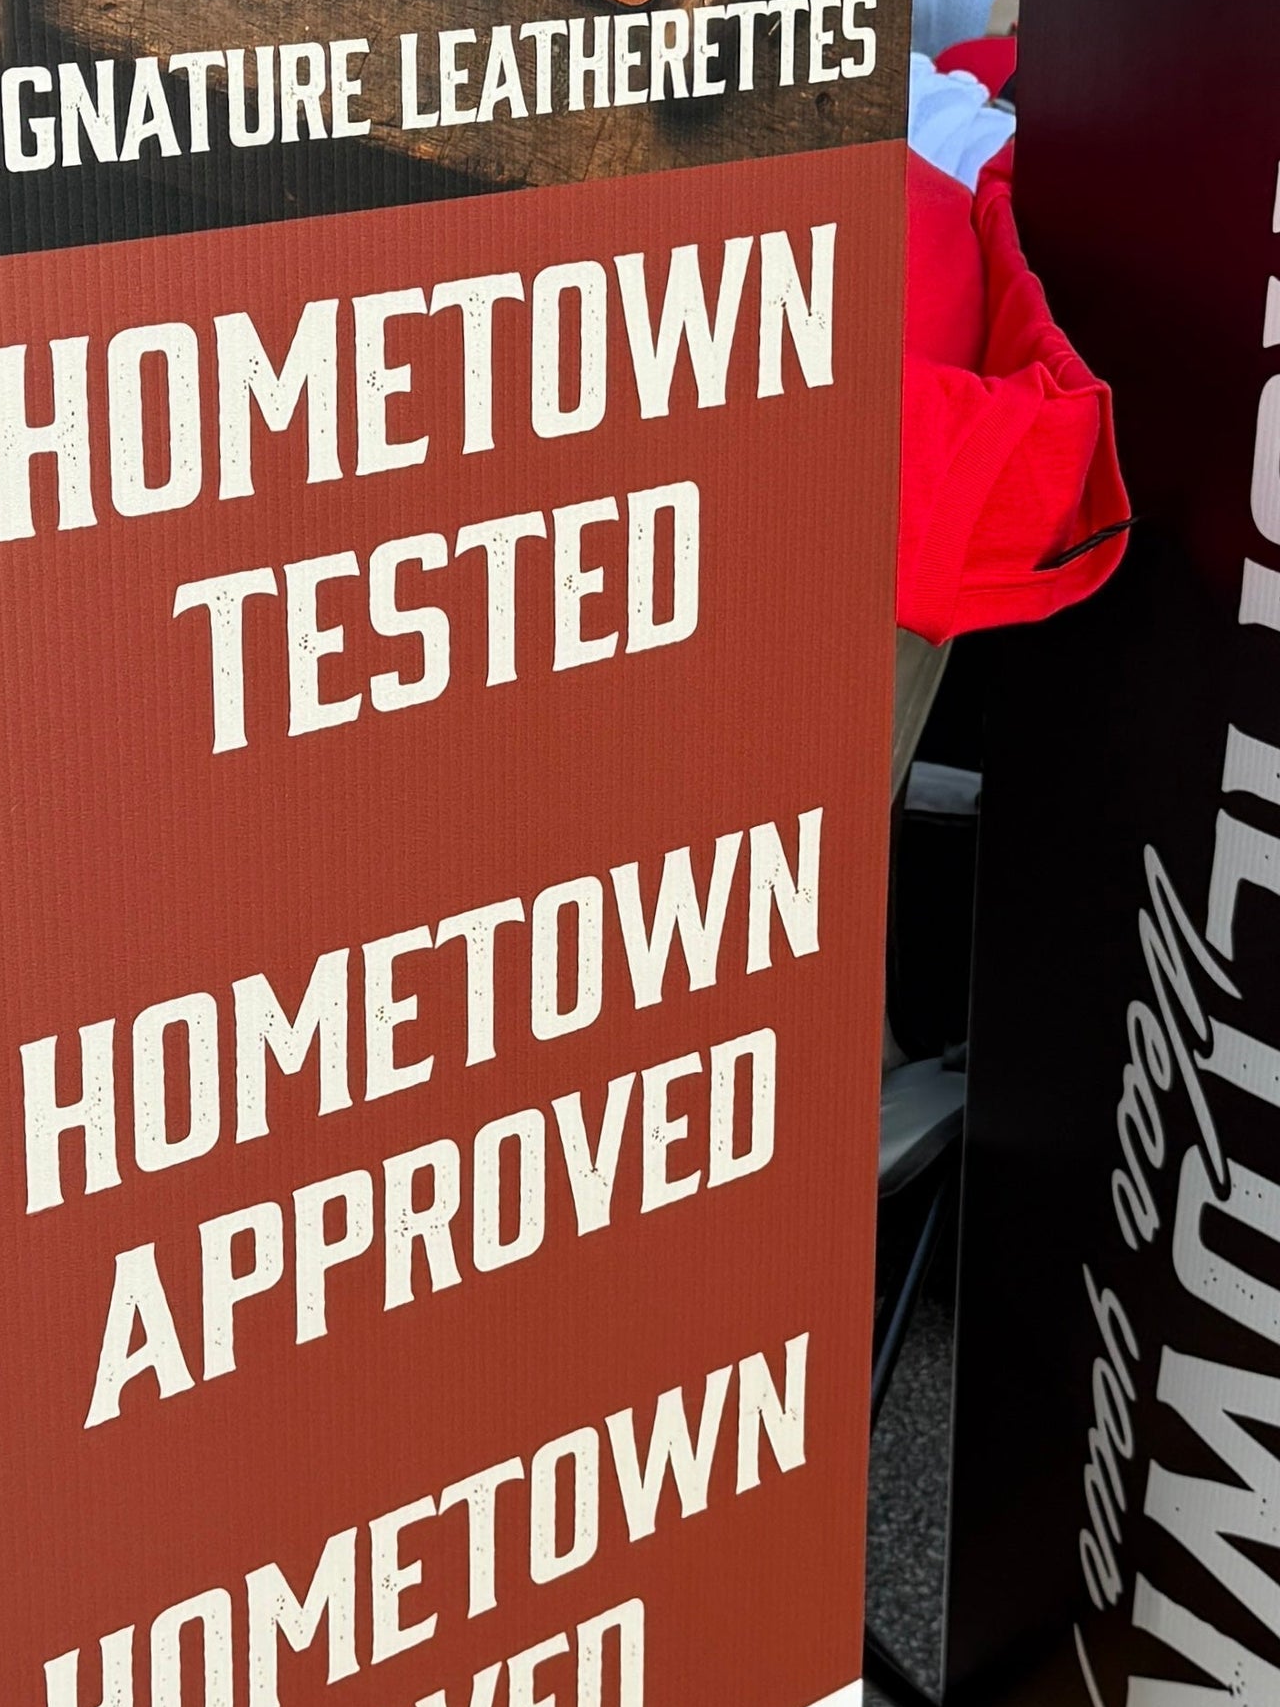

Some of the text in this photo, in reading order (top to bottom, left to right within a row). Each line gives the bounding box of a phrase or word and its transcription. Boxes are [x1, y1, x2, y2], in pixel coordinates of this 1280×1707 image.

[173, 480, 700, 755] TESTED
[20, 807, 824, 1215] HOMETOWN
[1111, 844, 1243, 1251] Wear
[84, 1027, 777, 1431] APPROVED
[1076, 1263, 1140, 1611] your
